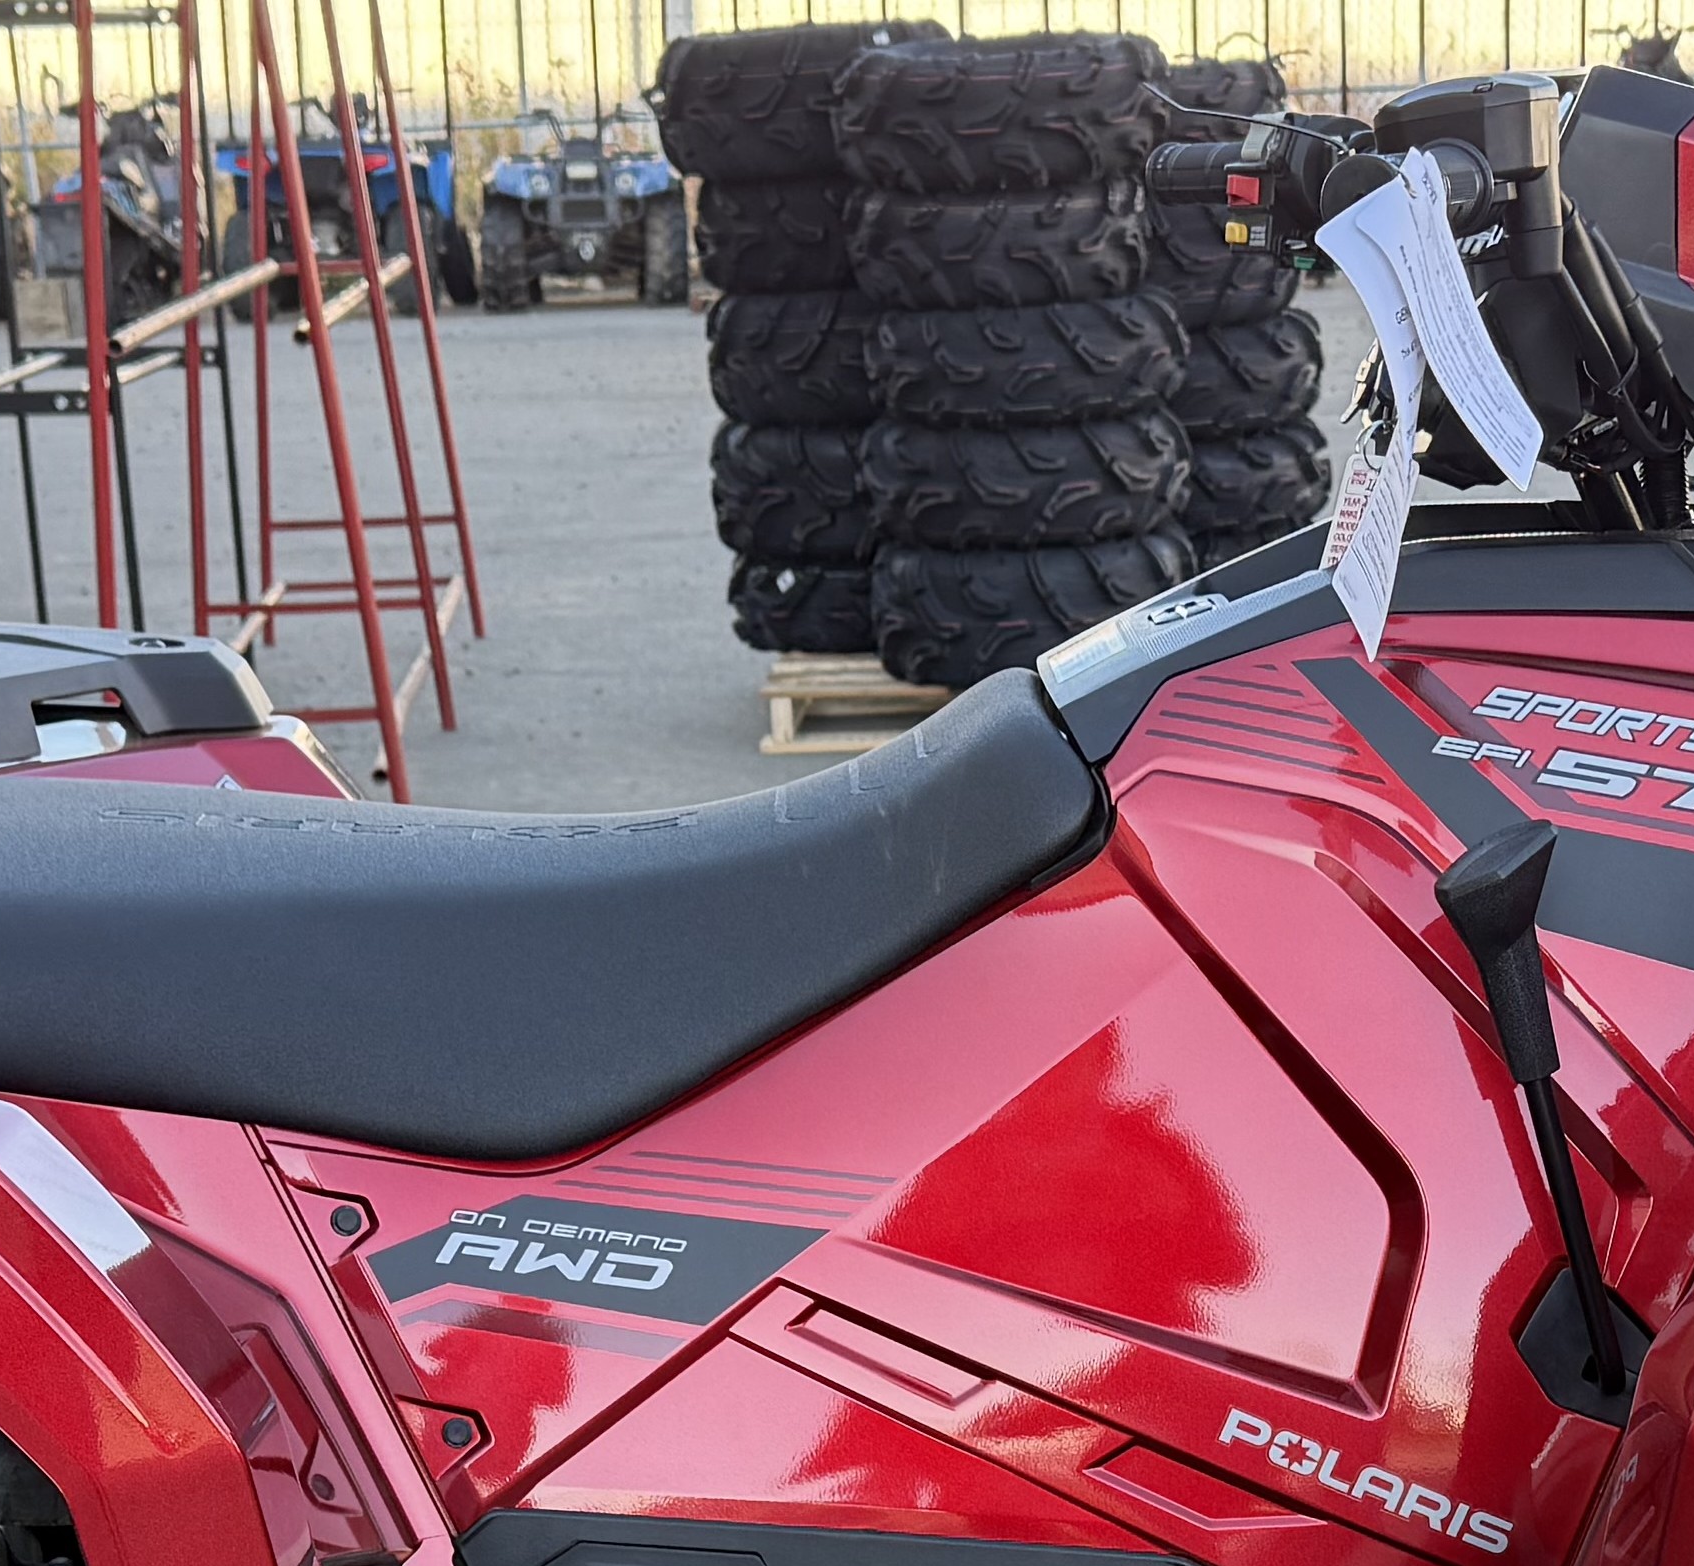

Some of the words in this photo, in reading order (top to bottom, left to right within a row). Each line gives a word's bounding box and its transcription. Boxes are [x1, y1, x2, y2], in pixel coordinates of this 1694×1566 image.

[1433, 735, 1532, 768] EFI
[450, 1210, 506, 1229] ON
[523, 1221, 686, 1252] DEMAND
[436, 1233, 672, 1290] AWD
[1218, 1408, 1513, 1553] POLARIS
